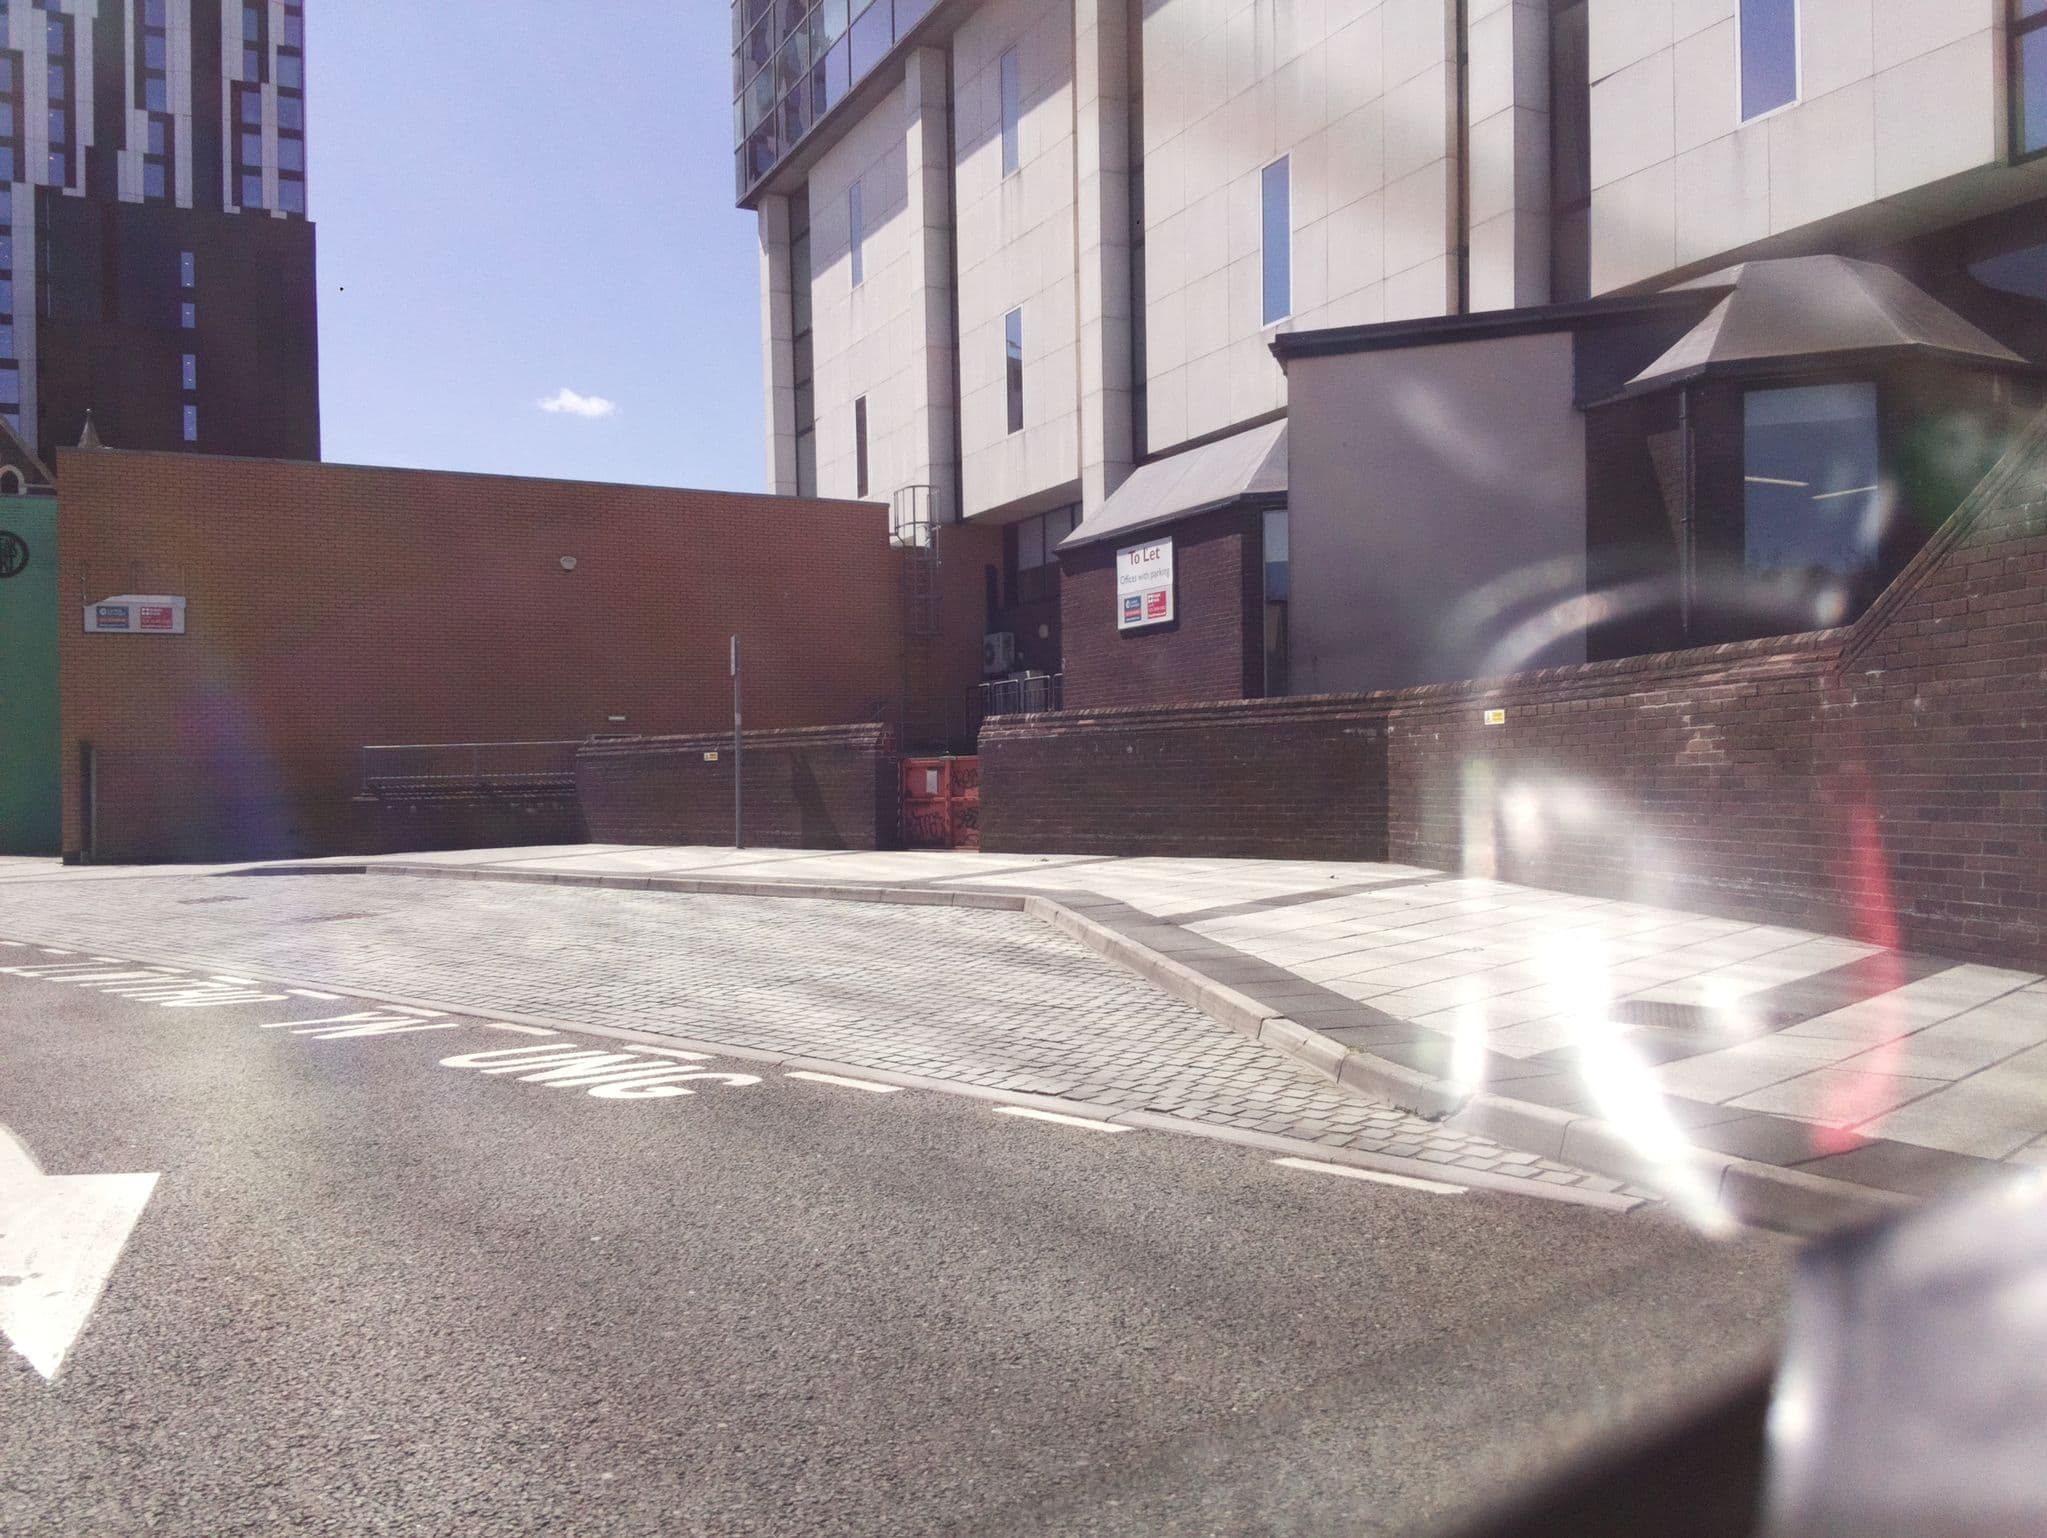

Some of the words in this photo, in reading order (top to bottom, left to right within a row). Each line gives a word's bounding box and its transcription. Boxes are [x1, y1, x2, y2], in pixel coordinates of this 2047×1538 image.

[1128, 550, 1140, 565] To
[1143, 547, 1160, 562] Let
[1120, 573, 1137, 585] Offices
[1138, 572, 1149, 581] with
[1150, 568, 1170, 580] parking
[260, 1011, 460, 1040] YN
[439, 1043, 763, 1100] UNIG
